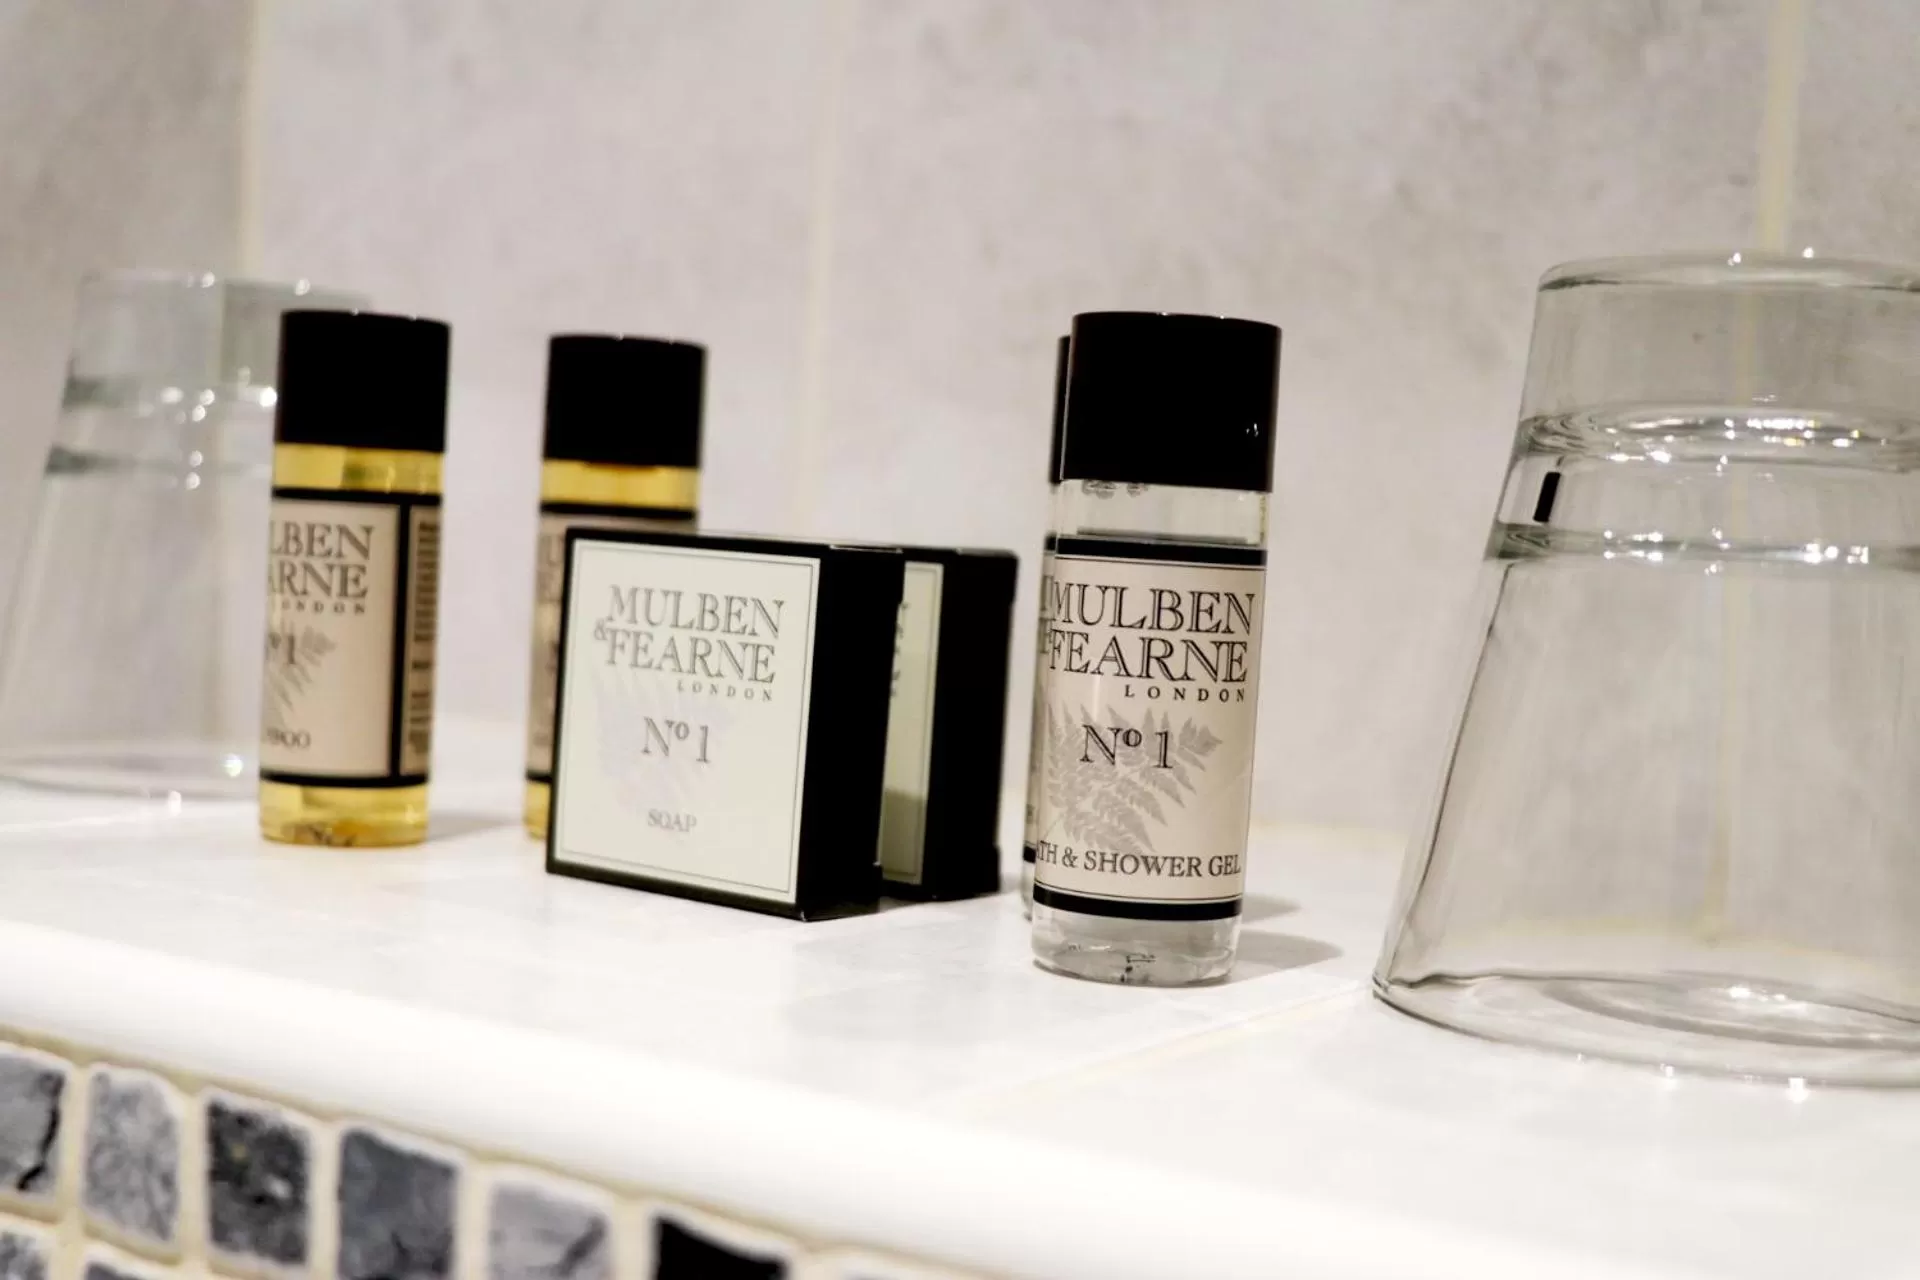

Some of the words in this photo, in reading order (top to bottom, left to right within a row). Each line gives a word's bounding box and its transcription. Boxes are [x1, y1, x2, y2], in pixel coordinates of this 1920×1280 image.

[606, 583, 785, 640] MULBEN
[1050, 580, 1256, 637] MULBEN
[1048, 628, 1249, 684] FEARNE
[676, 679, 773, 702] LONDON
[1124, 684, 1246, 703] LONDON
[647, 808, 698, 833] SOAP
[1061, 846, 1079, 869] &
[1083, 849, 1203, 879] SHOWER
[1207, 853, 1242, 878] GEL
